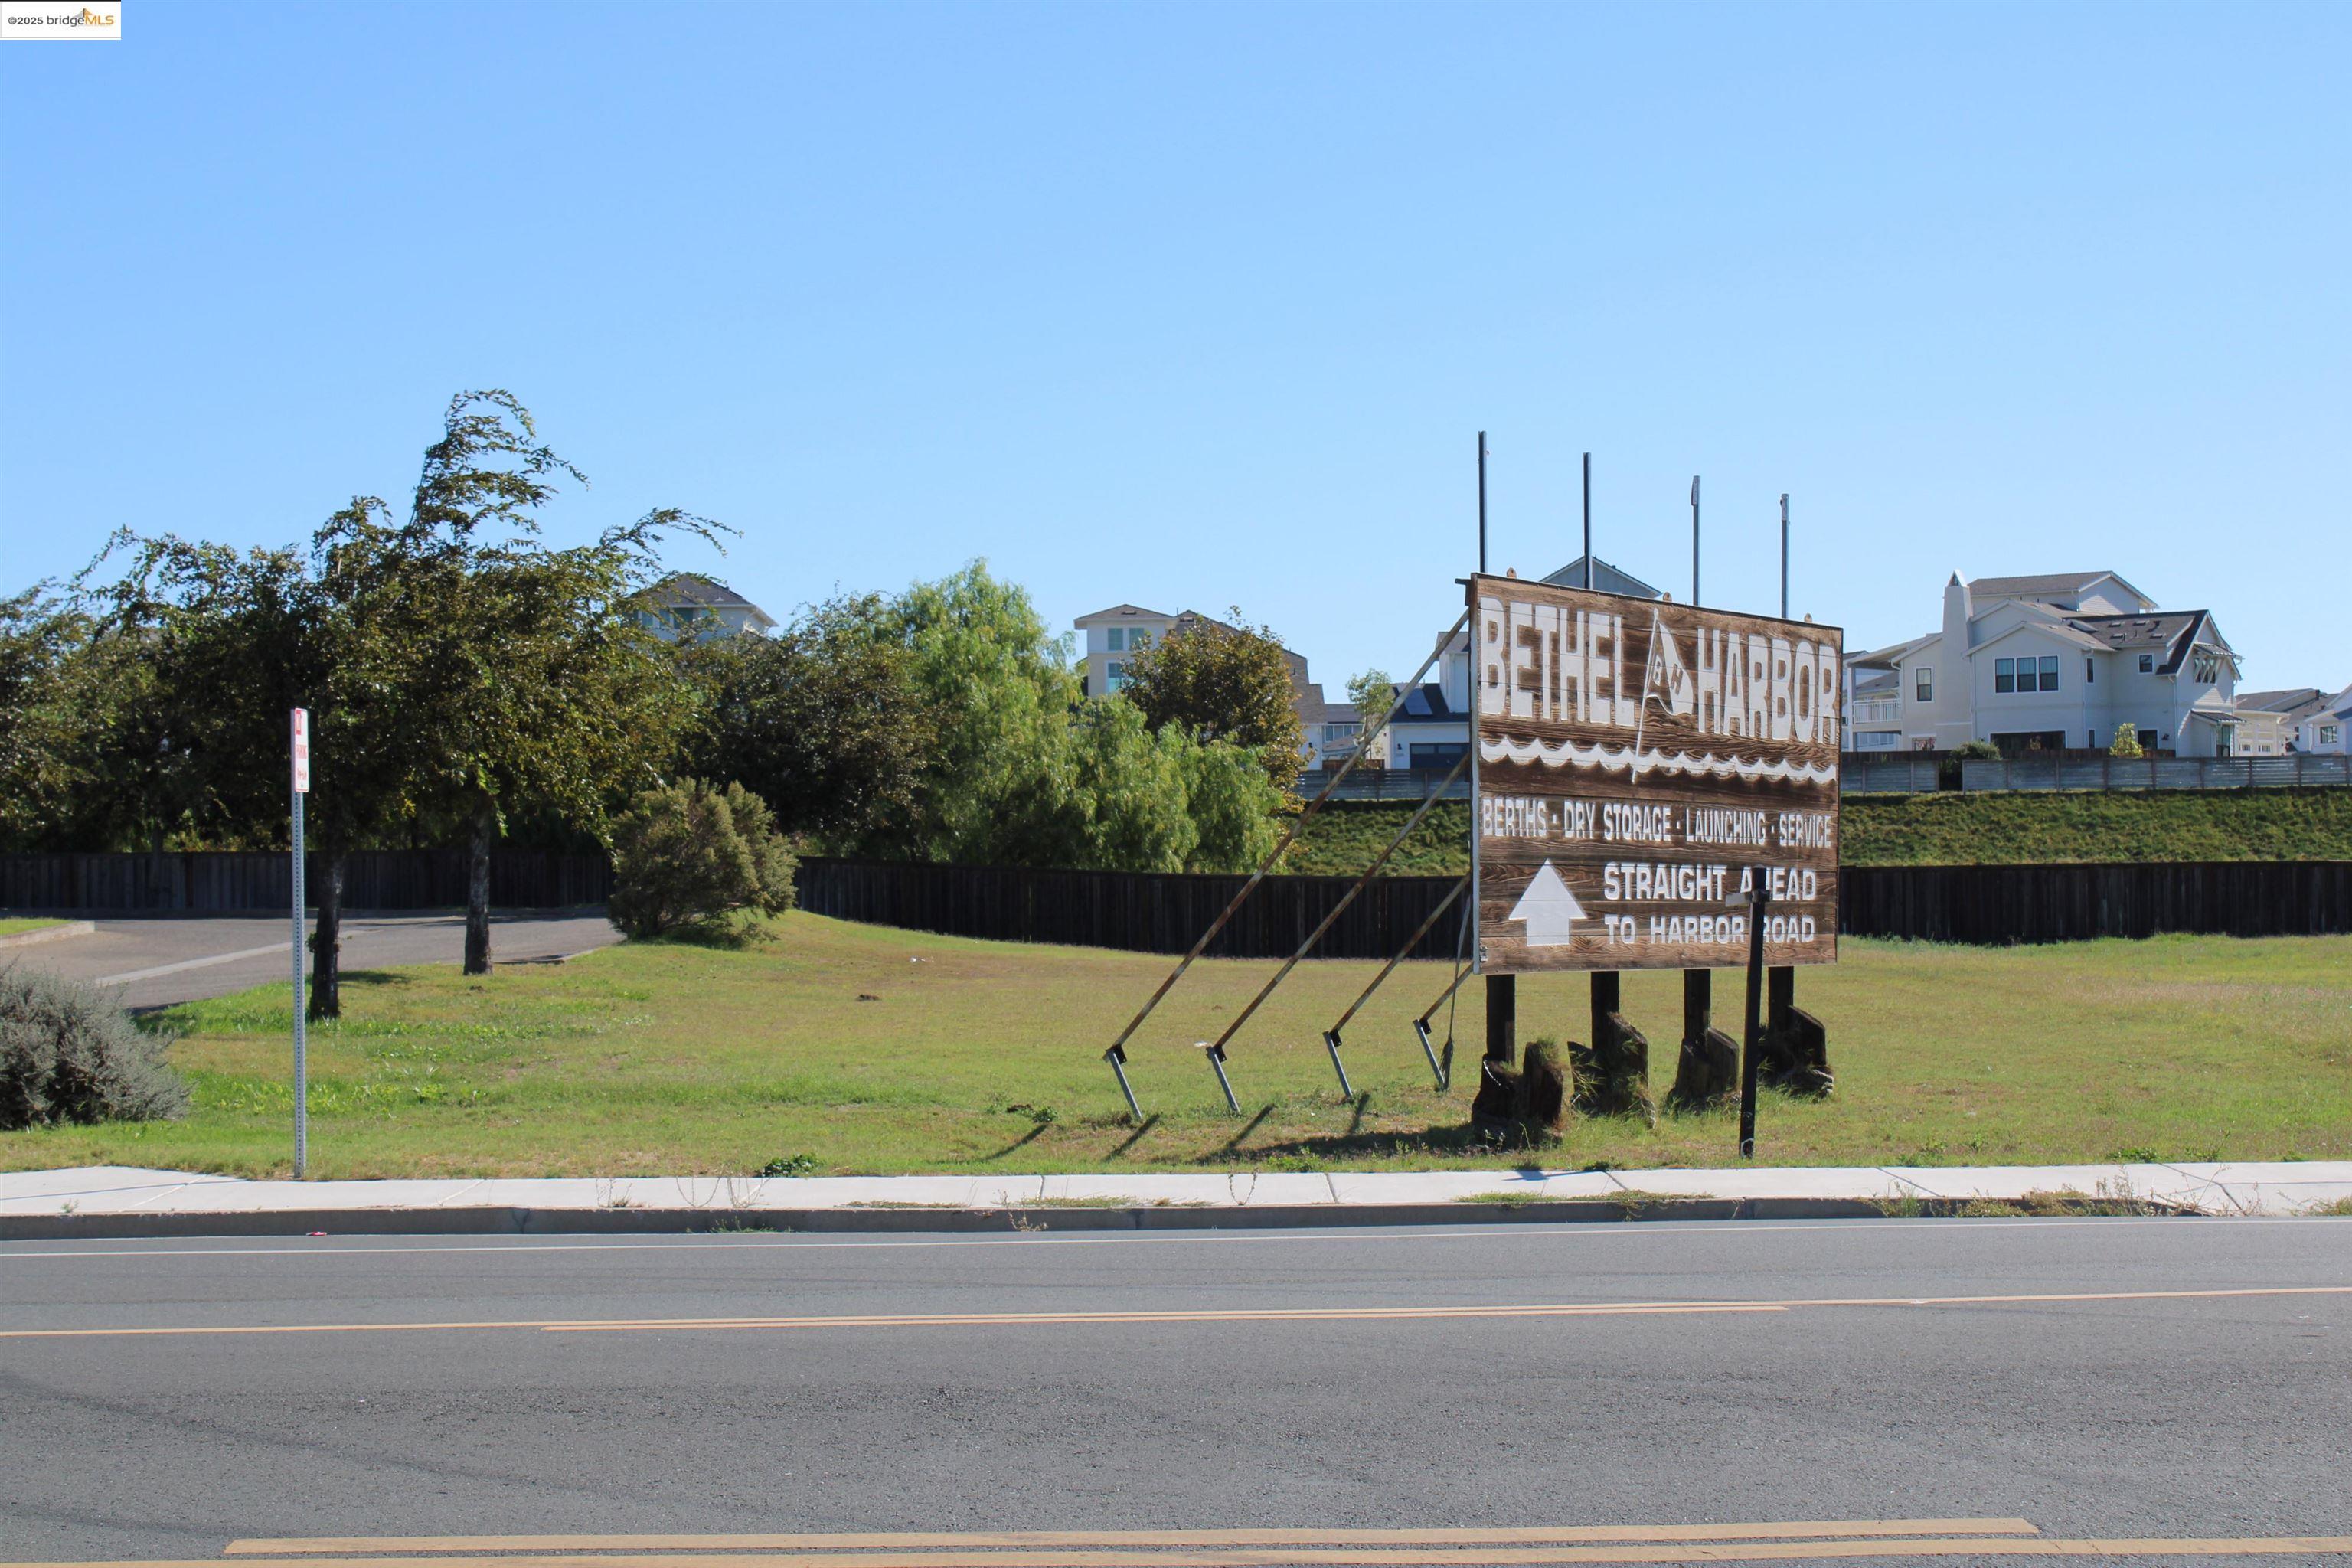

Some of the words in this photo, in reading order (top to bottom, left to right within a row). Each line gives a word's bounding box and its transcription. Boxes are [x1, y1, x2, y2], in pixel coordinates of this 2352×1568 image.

[1480, 596, 1635, 727] BETHEL
[1697, 627, 1837, 744] HARBOR
[1652, 654, 1663, 687] B
[1671, 663, 1684, 696] H
[1482, 799, 1547, 837] BERTHS
[1563, 800, 1596, 840] DRY
[1603, 803, 1671, 841] STORAGE
[1686, 808, 1766, 846] LAUNCHING
[1779, 813, 1832, 848] SERVICE
[1603, 861, 1727, 901] STRAIGHT
[1604, 914, 1635, 945] TO
[1651, 914, 1746, 944] HARBOR
